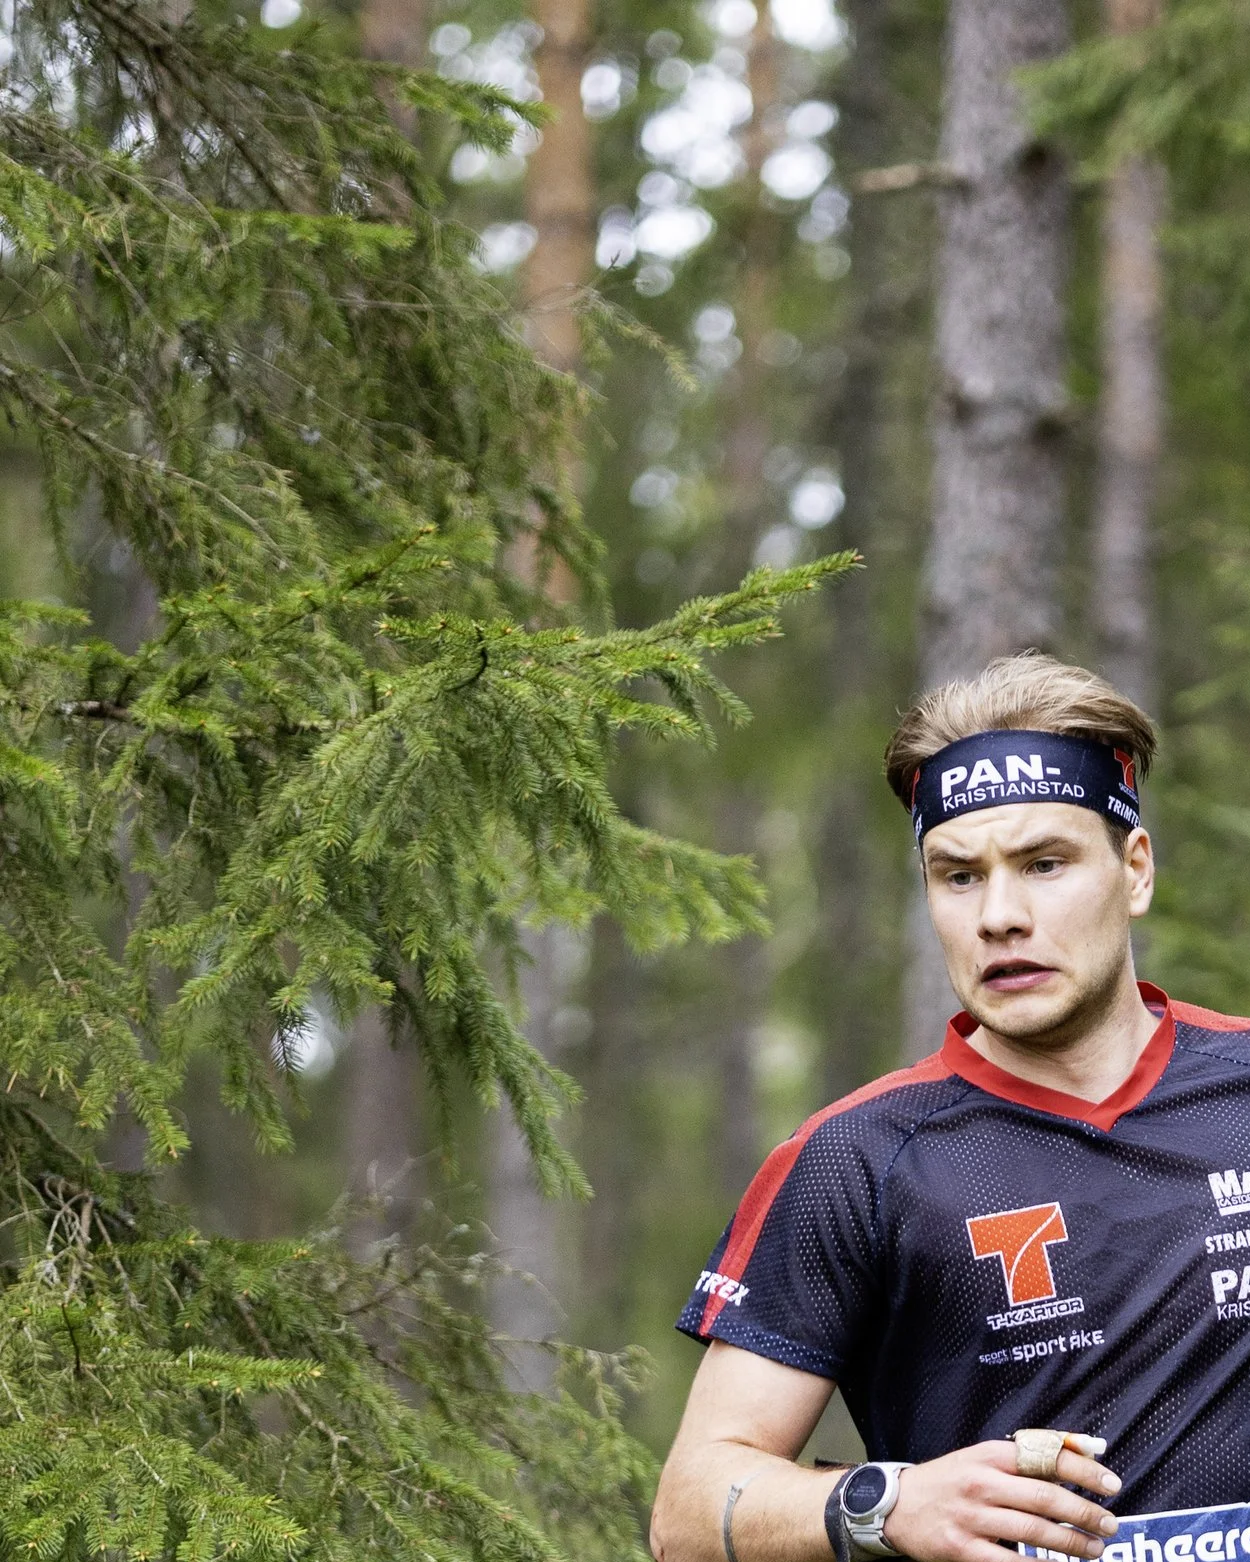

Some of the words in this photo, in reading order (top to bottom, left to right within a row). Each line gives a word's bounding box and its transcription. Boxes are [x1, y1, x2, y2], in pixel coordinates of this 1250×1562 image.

[941, 754, 1061, 799] PAN-
[942, 781, 1085, 812] KRISTIANSTAD
[986, 1297, 1085, 1331] T-KARTOR
[1012, 1335, 1067, 1362] sport
